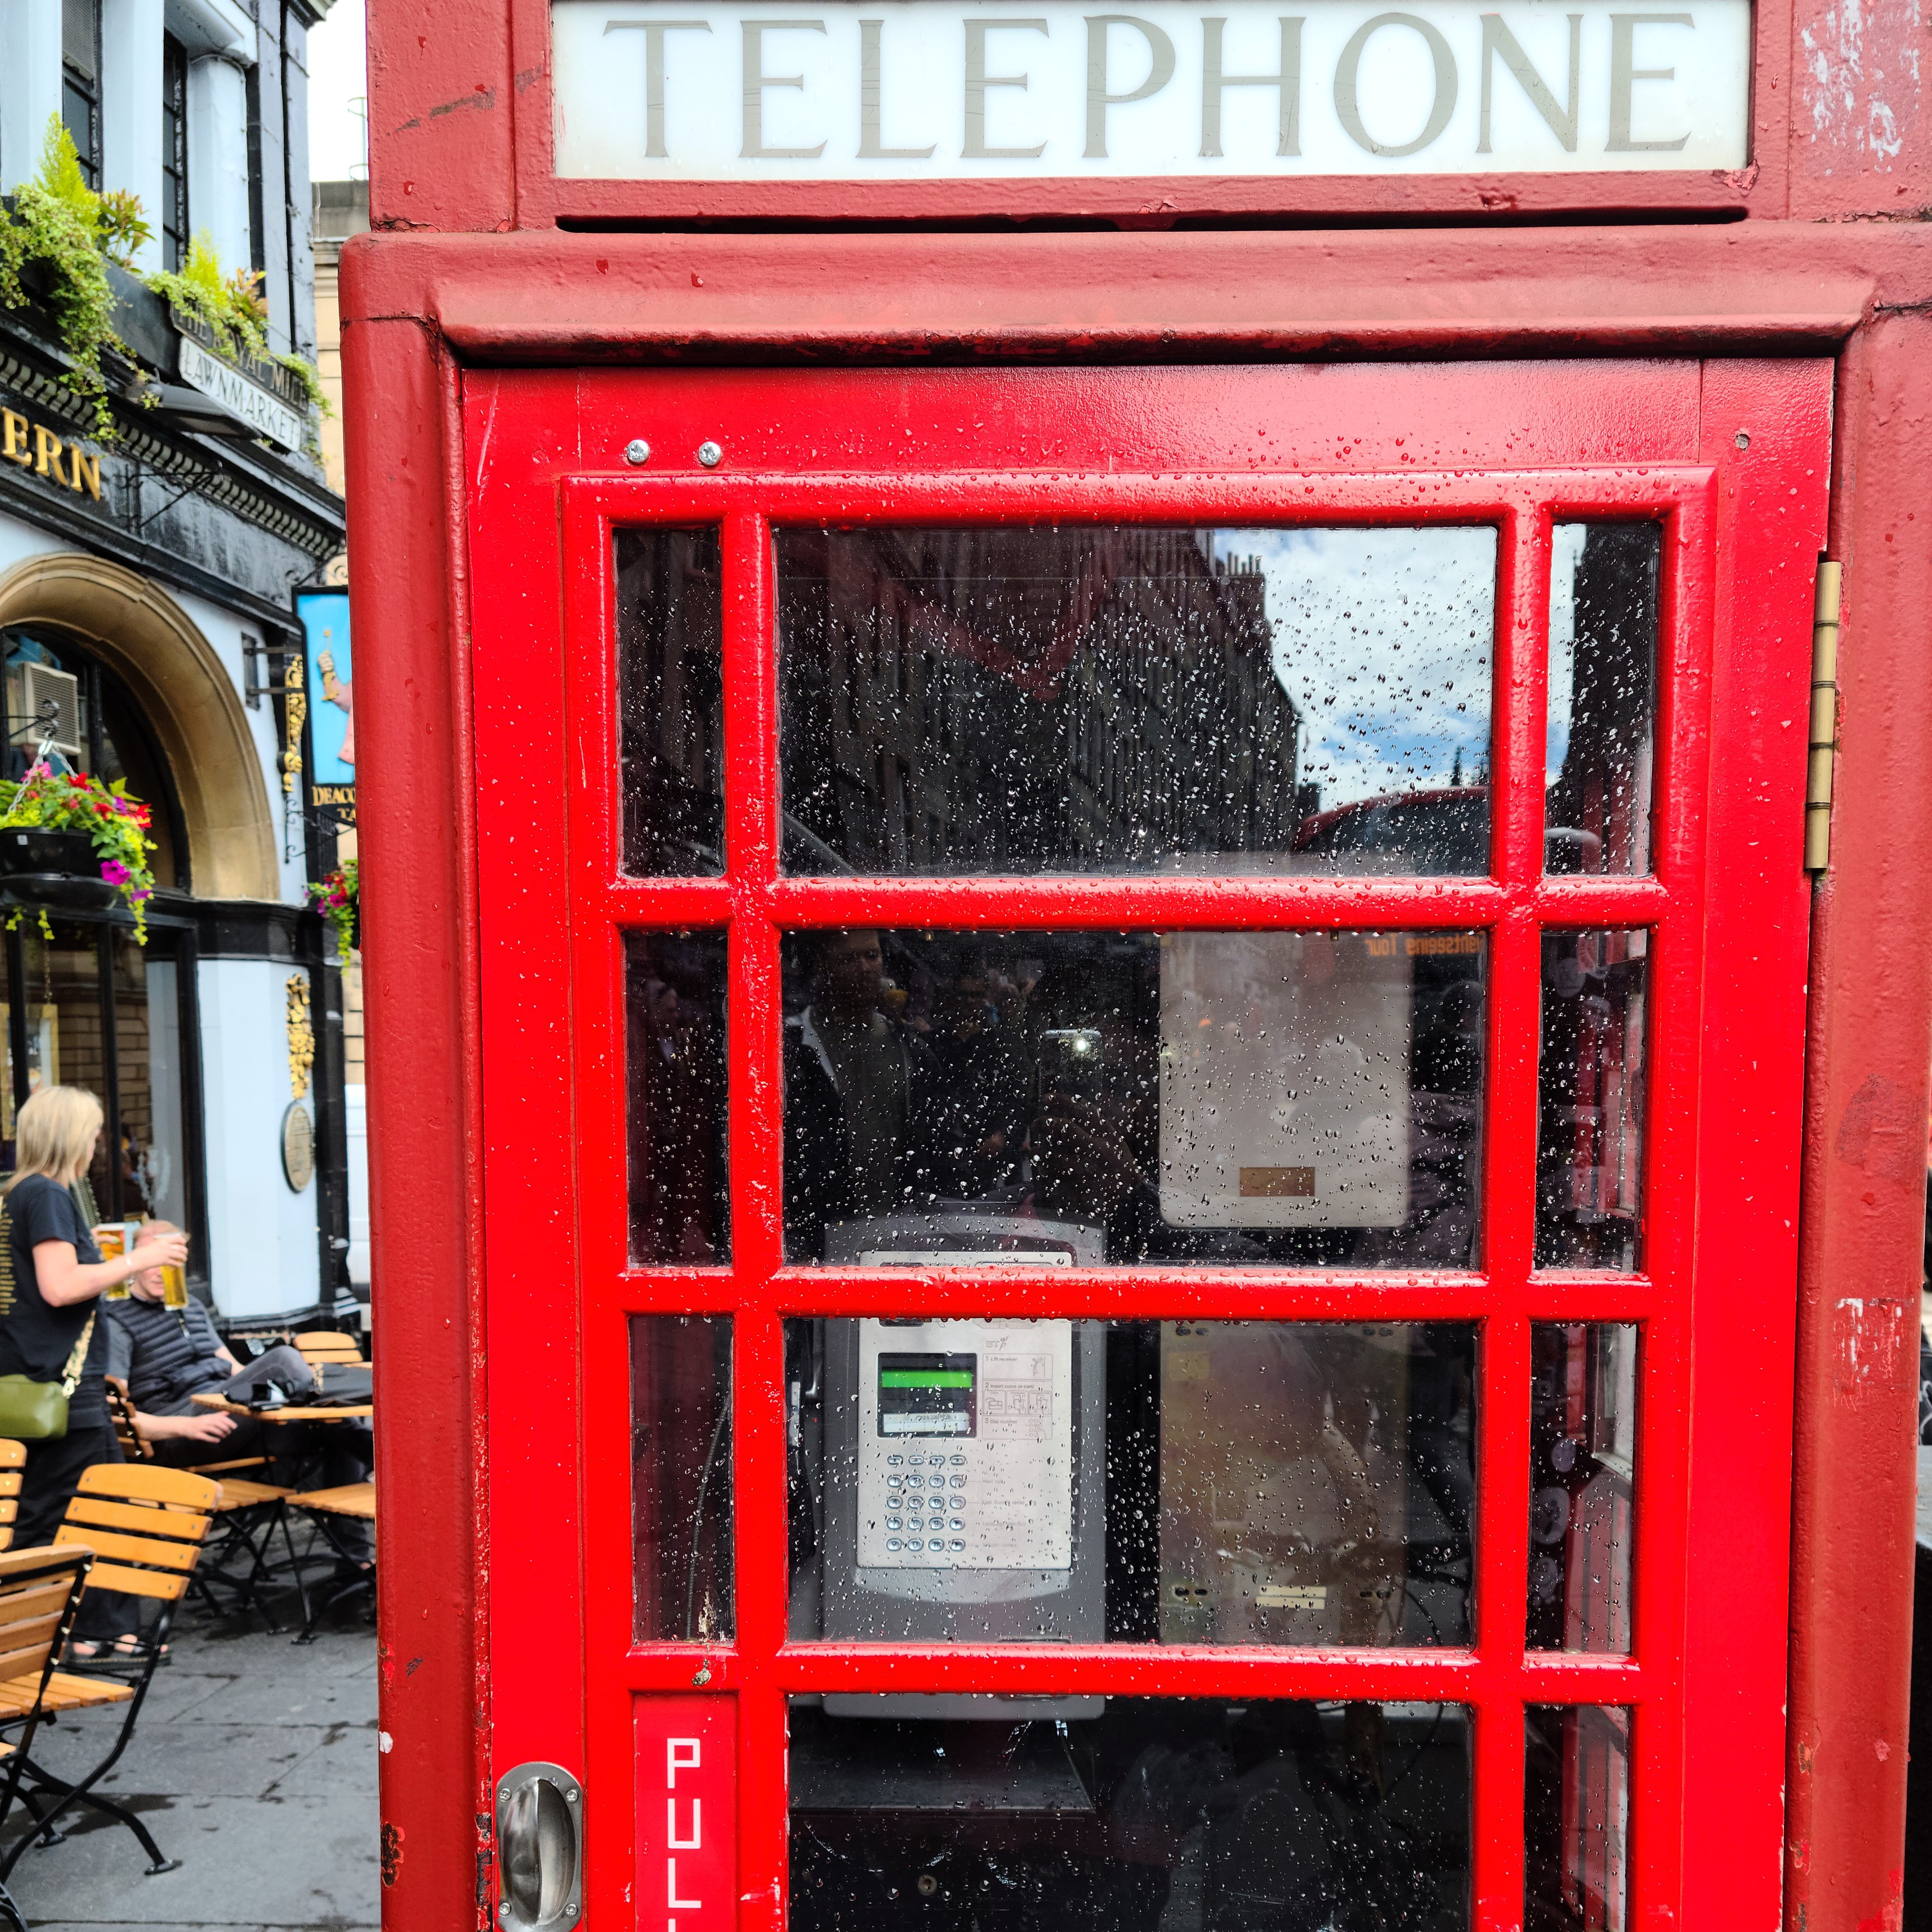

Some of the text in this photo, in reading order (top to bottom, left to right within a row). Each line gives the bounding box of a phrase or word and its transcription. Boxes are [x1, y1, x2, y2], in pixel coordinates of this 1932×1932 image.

[601, 12, 1698, 159] TELEPHONE
[1, 406, 101, 502] ERN
[184, 342, 299, 445] LAWNMARKET
[667, 1738, 701, 1932] PUL
